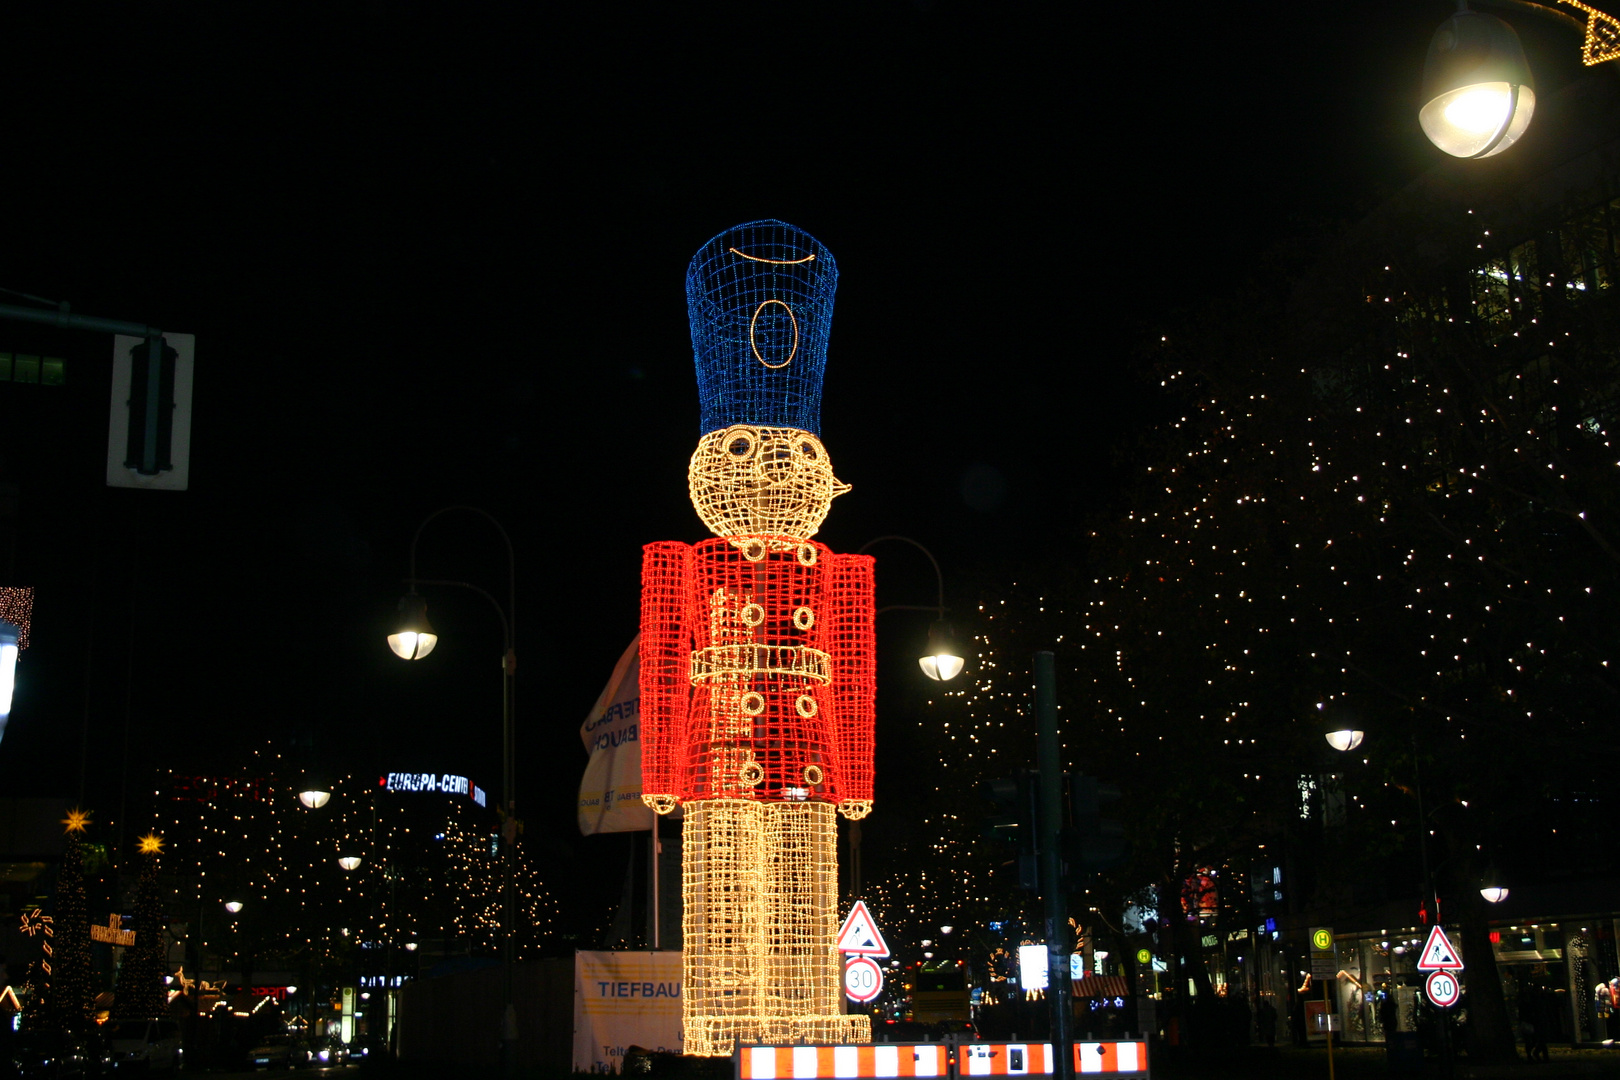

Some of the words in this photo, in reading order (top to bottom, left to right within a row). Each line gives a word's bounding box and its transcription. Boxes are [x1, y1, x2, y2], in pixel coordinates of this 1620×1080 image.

[850, 970, 872, 988] 30
[598, 982, 681, 998] TIEFBAU
[1433, 980, 1452, 997] 30
